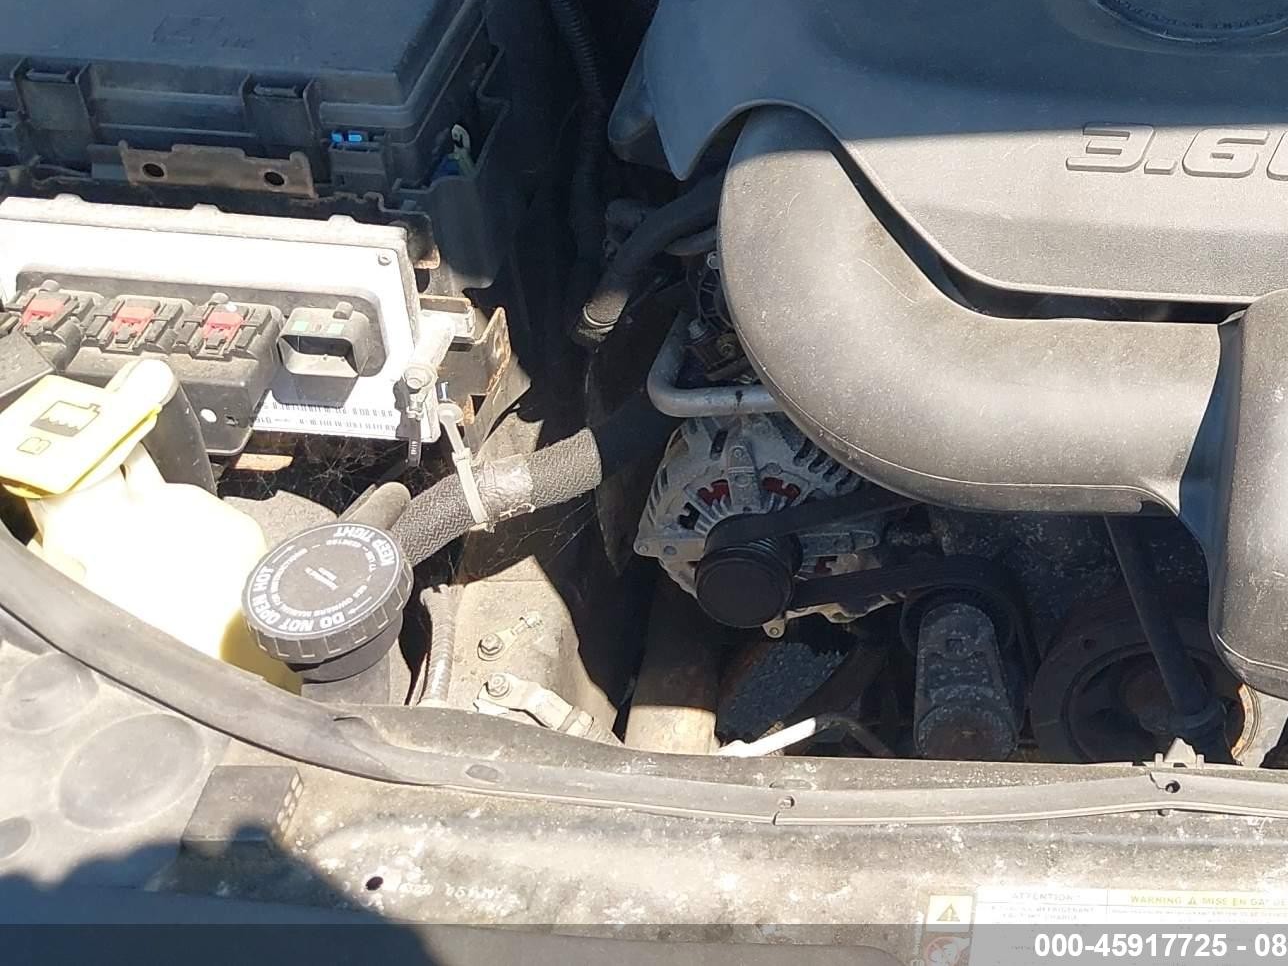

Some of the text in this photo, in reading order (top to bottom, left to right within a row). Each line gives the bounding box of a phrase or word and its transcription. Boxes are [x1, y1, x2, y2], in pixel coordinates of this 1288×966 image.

[333, 526, 375, 542] TIGHT
[371, 538, 395, 566] KEEP
[252, 566, 345, 631] DO NOT OPEN HOT
[1130, 895, 1182, 905] WARNING
[1202, 897, 1228, 906] MISE
[1250, 898, 1288, 907] GADE
